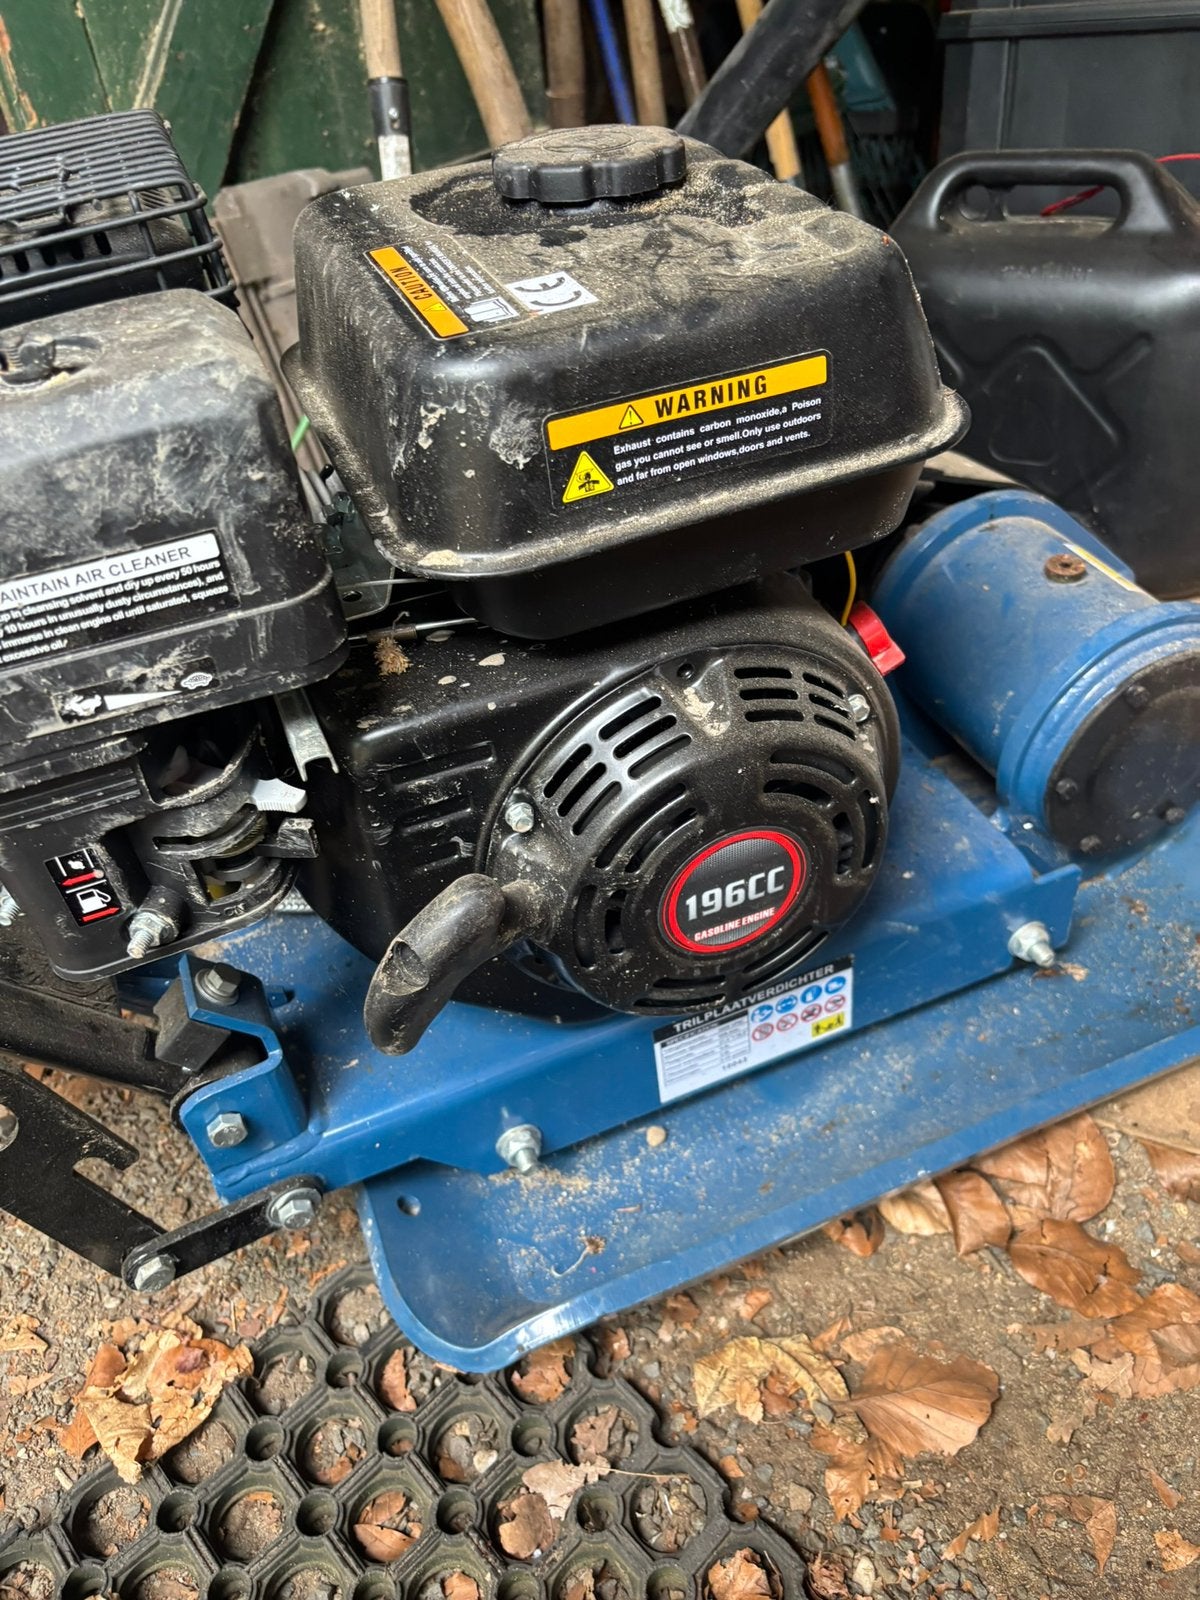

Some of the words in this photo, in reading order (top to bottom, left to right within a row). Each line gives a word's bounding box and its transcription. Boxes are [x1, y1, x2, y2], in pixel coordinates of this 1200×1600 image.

[390, 265, 433, 301] CAUTION
[655, 374, 768, 419] WARNING
[613, 438, 652, 456] Exhaust
[655, 426, 696, 444] contains
[699, 418, 732, 434] carbon
[735, 405, 788, 425] monoxide,a
[791, 397, 822, 412] Poison
[615, 460, 632, 473] gas
[633, 455, 651, 469] you
[652, 445, 684, 461] cannot
[685, 441, 703, 452] see
[703, 438, 715, 448] or
[764, 424, 781, 434] use
[782, 412, 822, 430] outdoors
[616, 474, 635, 487] and
[635, 469, 649, 482] far
[650, 463, 671, 478] from
[673, 458, 696, 472] open
[697, 441, 765, 465] windows,doors
[766, 435, 783, 449] and
[784, 430, 811, 443] vents.
[11, 608, 22, 619] in
[22, 597, 70, 616] cleansing
[69, 587, 105, 605] solvent
[105, 583, 124, 598] and
[124, 579, 140, 591] dry
[141, 577, 154, 587] up
[155, 570, 180, 583] every
[181, 565, 192, 577] 50
[193, 560, 221, 573] hours
[75, 567, 105, 584] AIR
[108, 546, 192, 578] CLEANER
[2, 633, 43, 650] immerse
[43, 628, 54, 639] in
[54, 622, 80, 637] clean
[80, 615, 112, 629] engine
[112, 609, 125, 621] oil
[125, 604, 146, 618] until
[191, 585, 229, 601] squeeze
[4, 623, 17, 635] 10
[17, 616, 48, 632] hours
[47, 613, 58, 624] in
[58, 602, 104, 621] unusually
[105, 596, 132, 610] dusty
[205, 571, 224, 585] and
[3, 645, 51, 663] excessive
[685, 865, 785, 921] 196CC
[694, 919, 741, 942] GASOLINE
[741, 906, 777, 926] ENGINE
[673, 964, 836, 1033] TRILPLAATVERDICHTER
